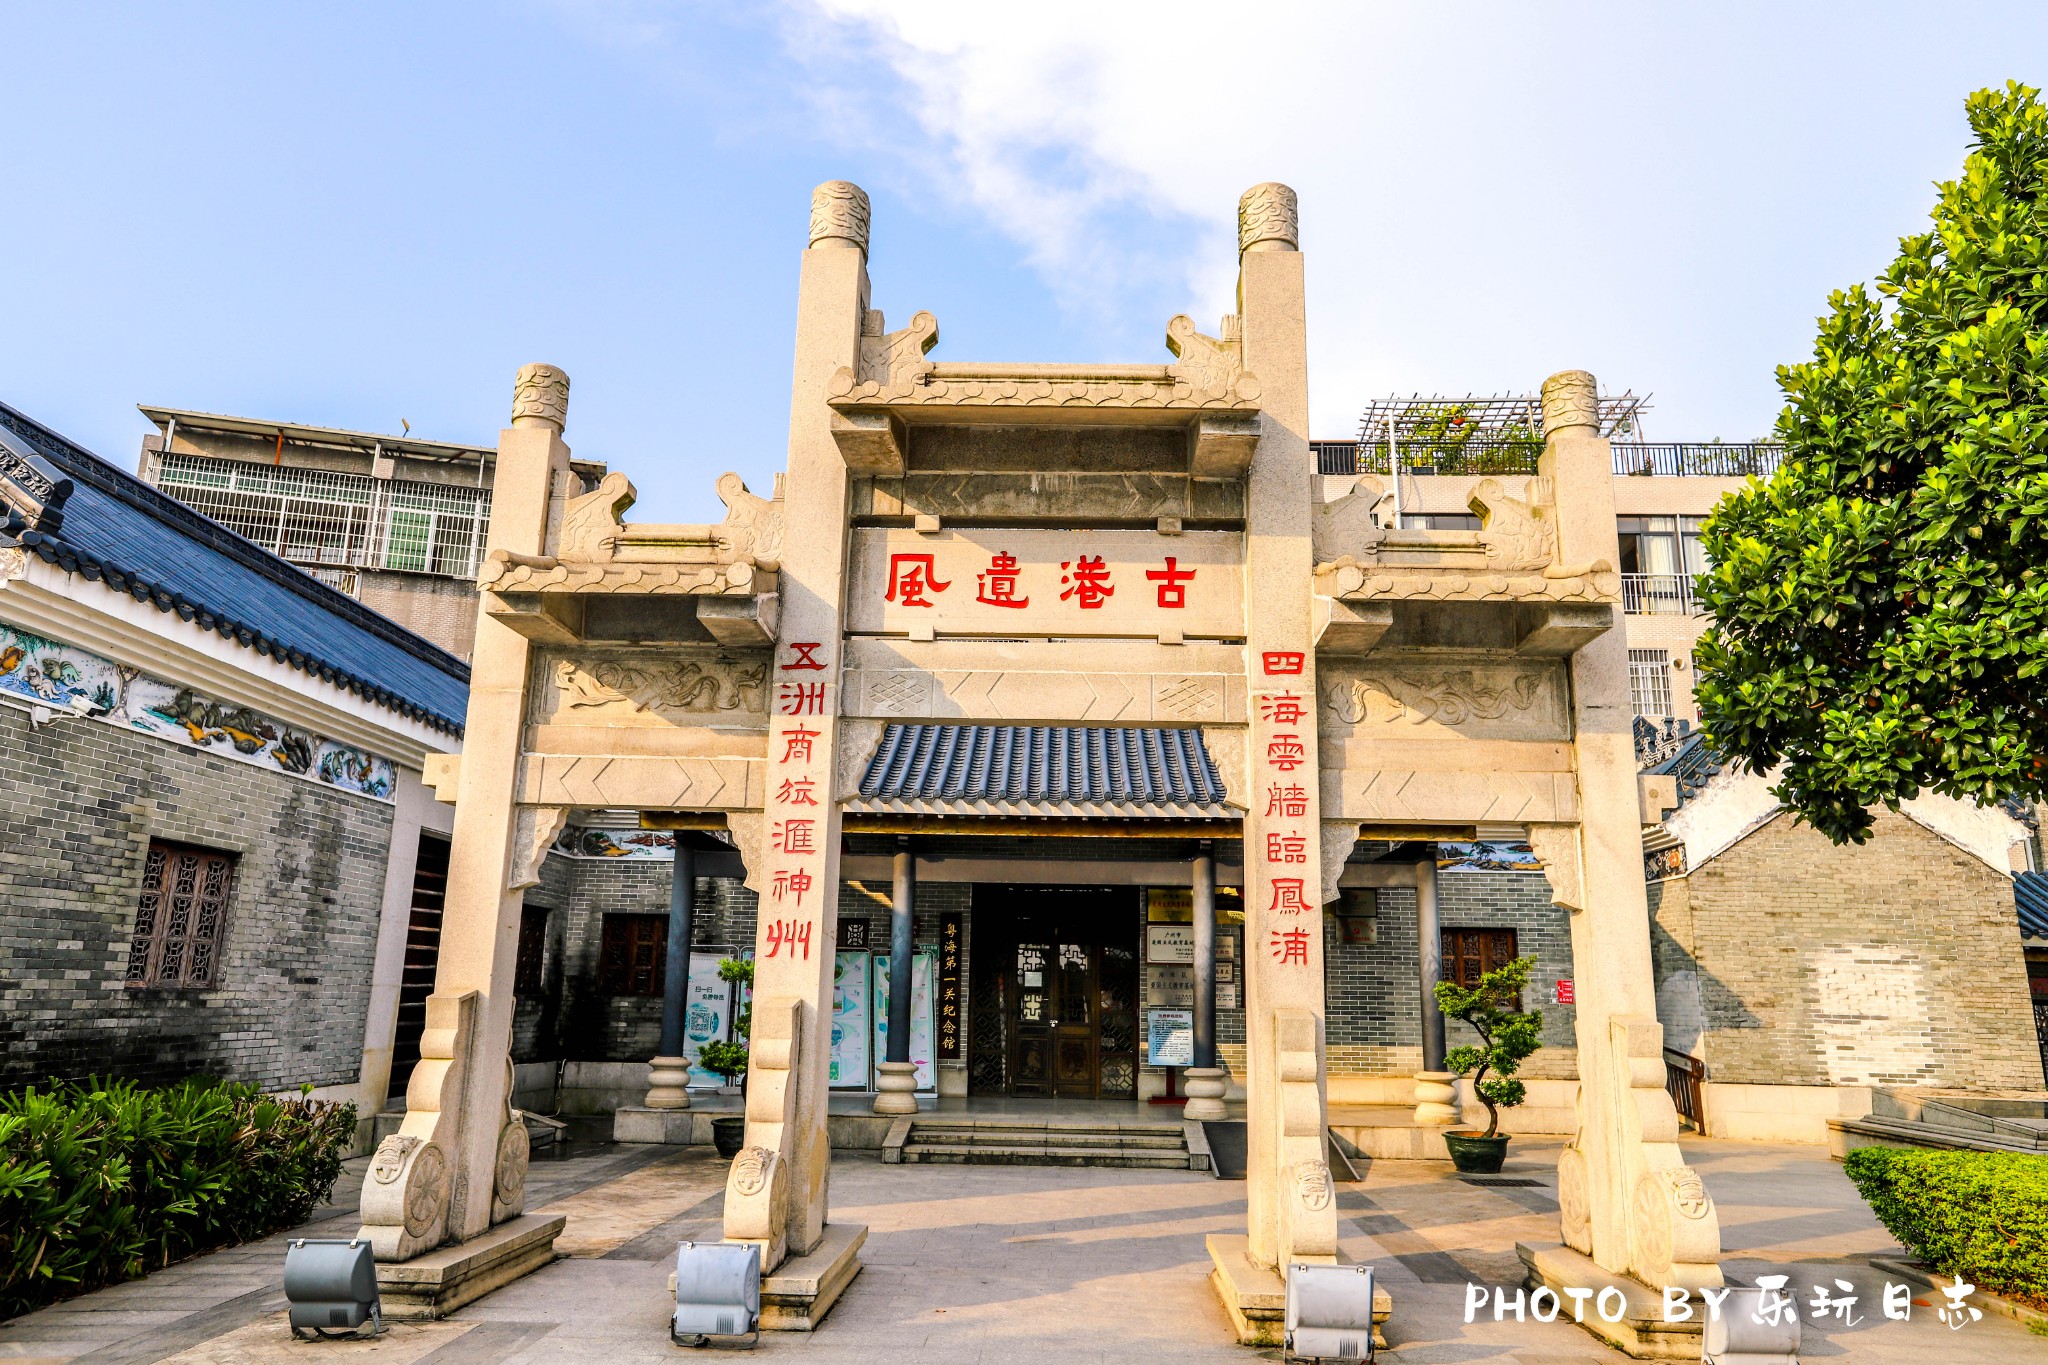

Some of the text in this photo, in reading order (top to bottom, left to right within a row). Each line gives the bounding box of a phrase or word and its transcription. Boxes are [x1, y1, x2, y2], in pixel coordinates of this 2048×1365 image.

[942, 922, 958, 1050] 粤海第一关纪念馆
